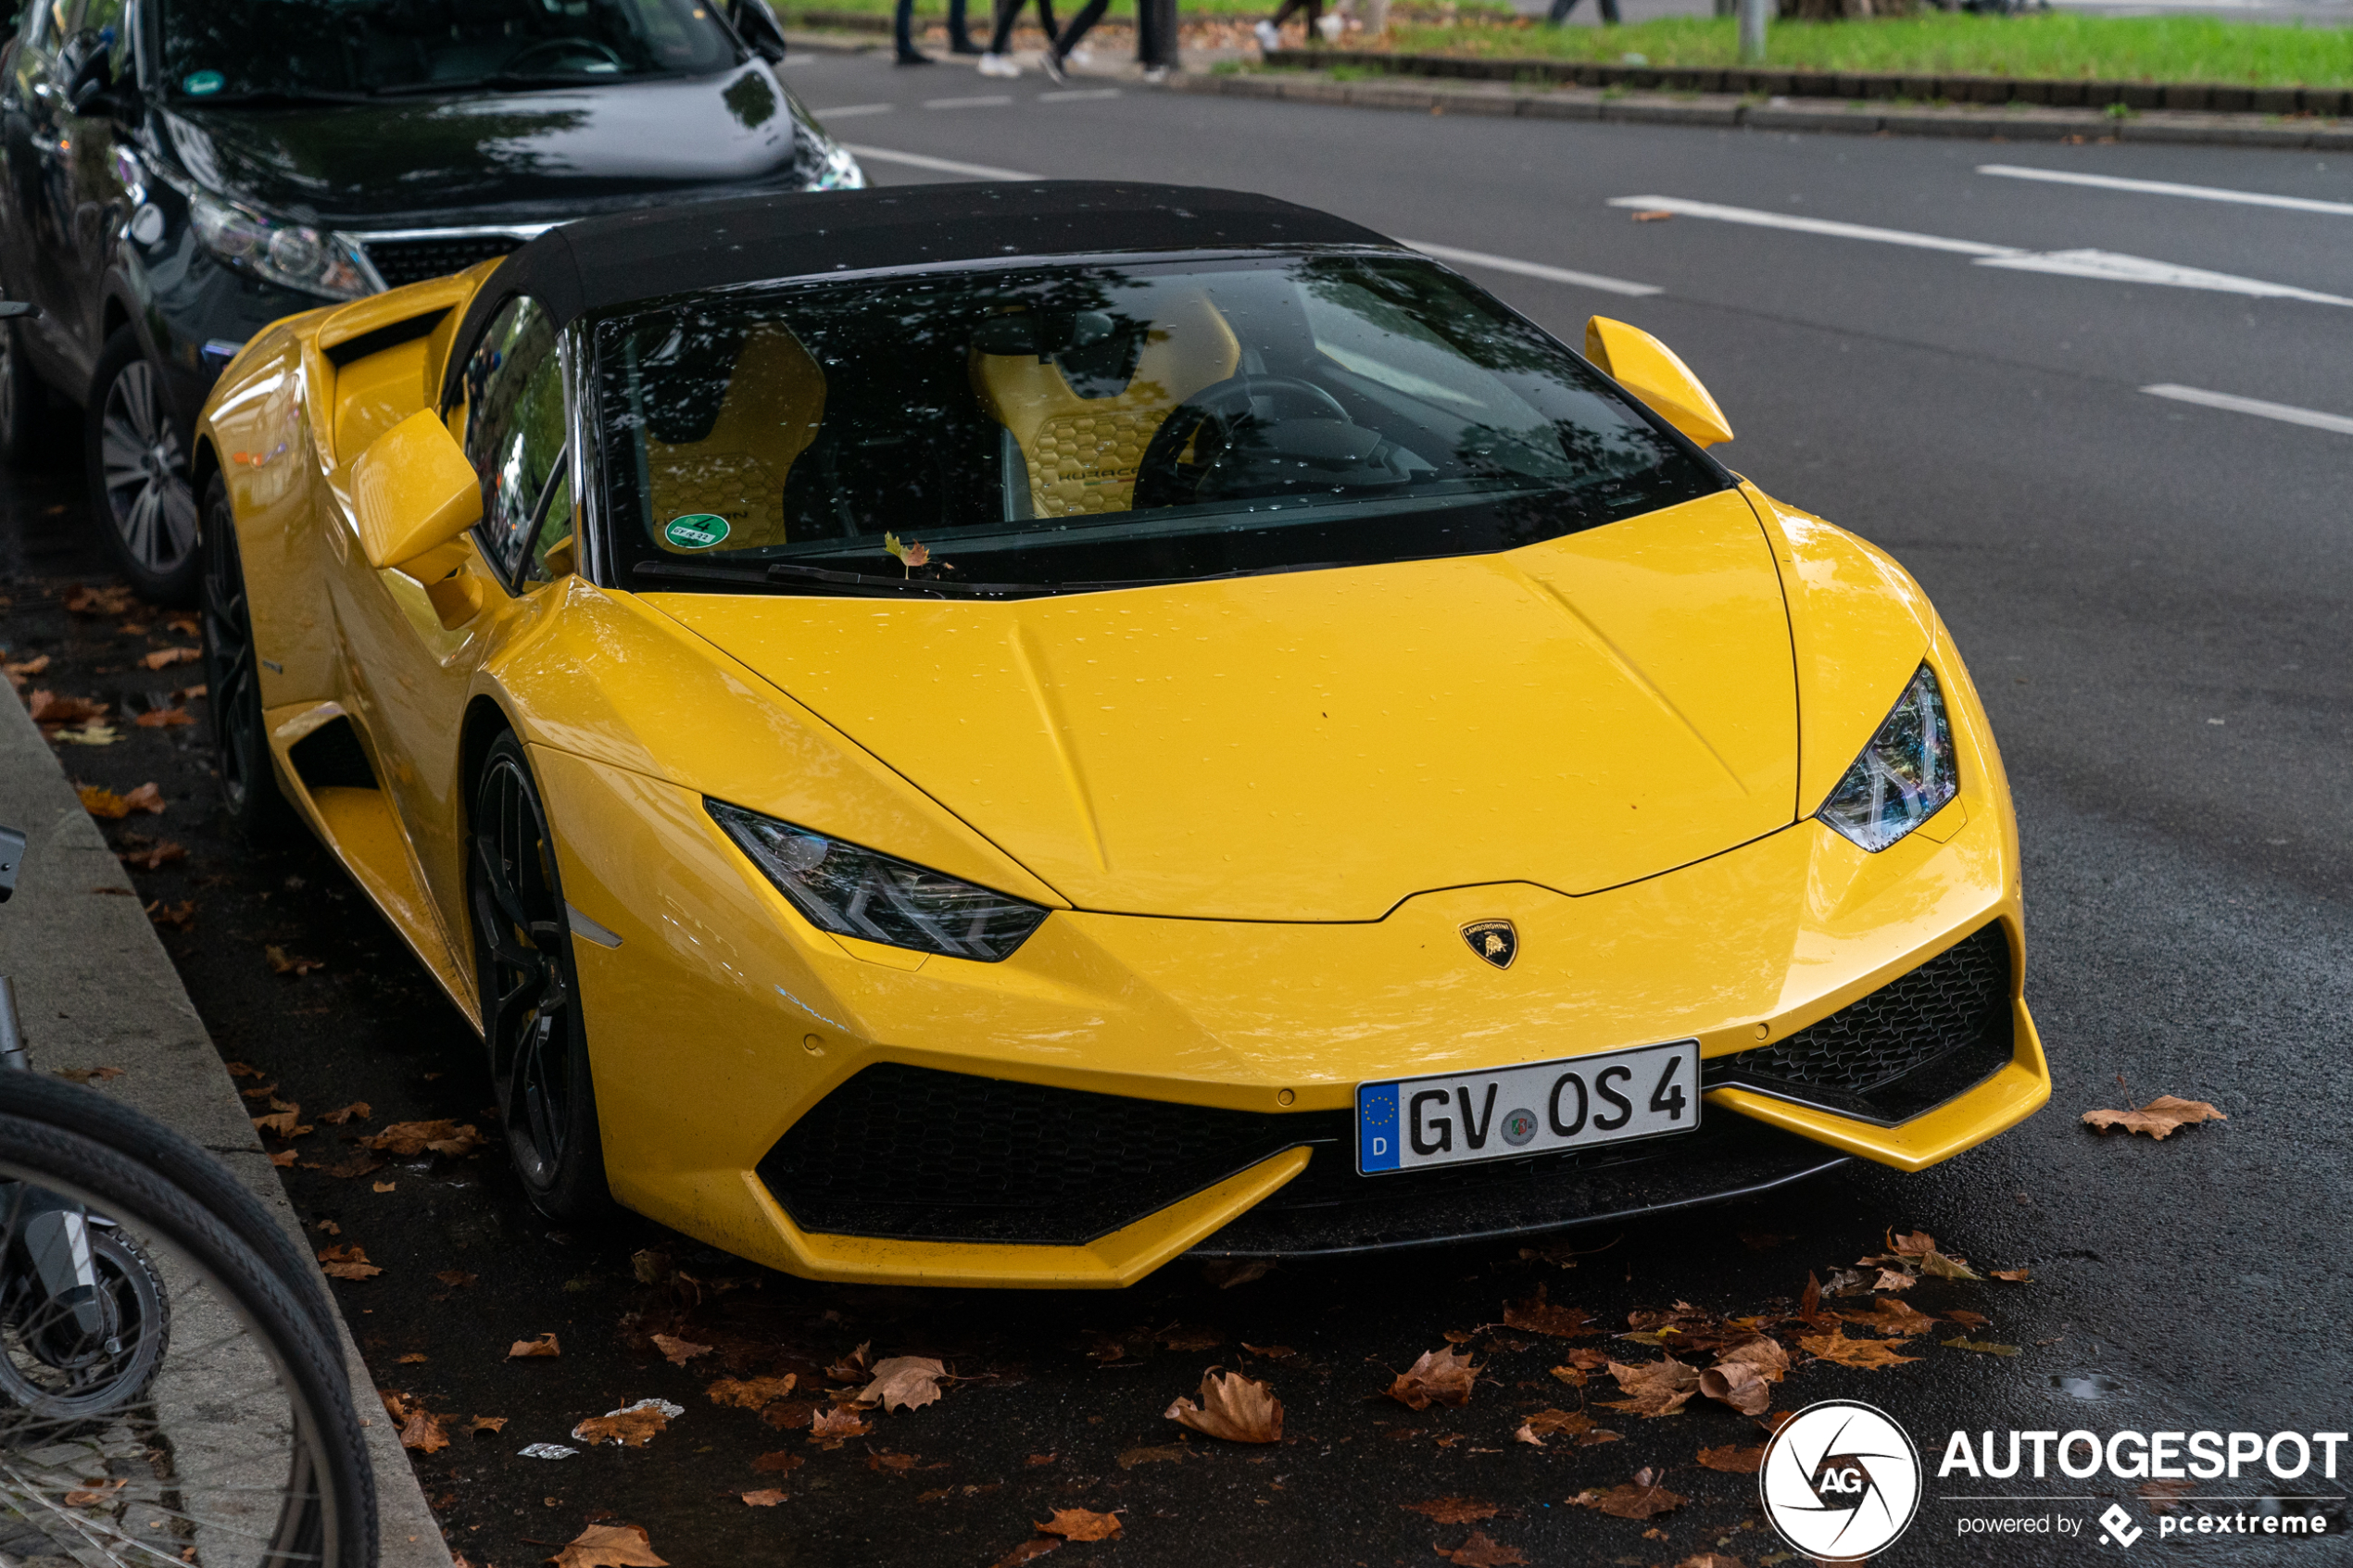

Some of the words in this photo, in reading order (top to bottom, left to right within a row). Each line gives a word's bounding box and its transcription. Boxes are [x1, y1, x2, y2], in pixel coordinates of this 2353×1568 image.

[694, 518, 714, 531] 4
[1465, 923, 1509, 935] LAMBORGHINI
[1410, 1083, 1498, 1155] GV
[1549, 1065, 1633, 1136] OS
[1650, 1056, 1686, 1121] 4
[1373, 1136, 1388, 1157] D
